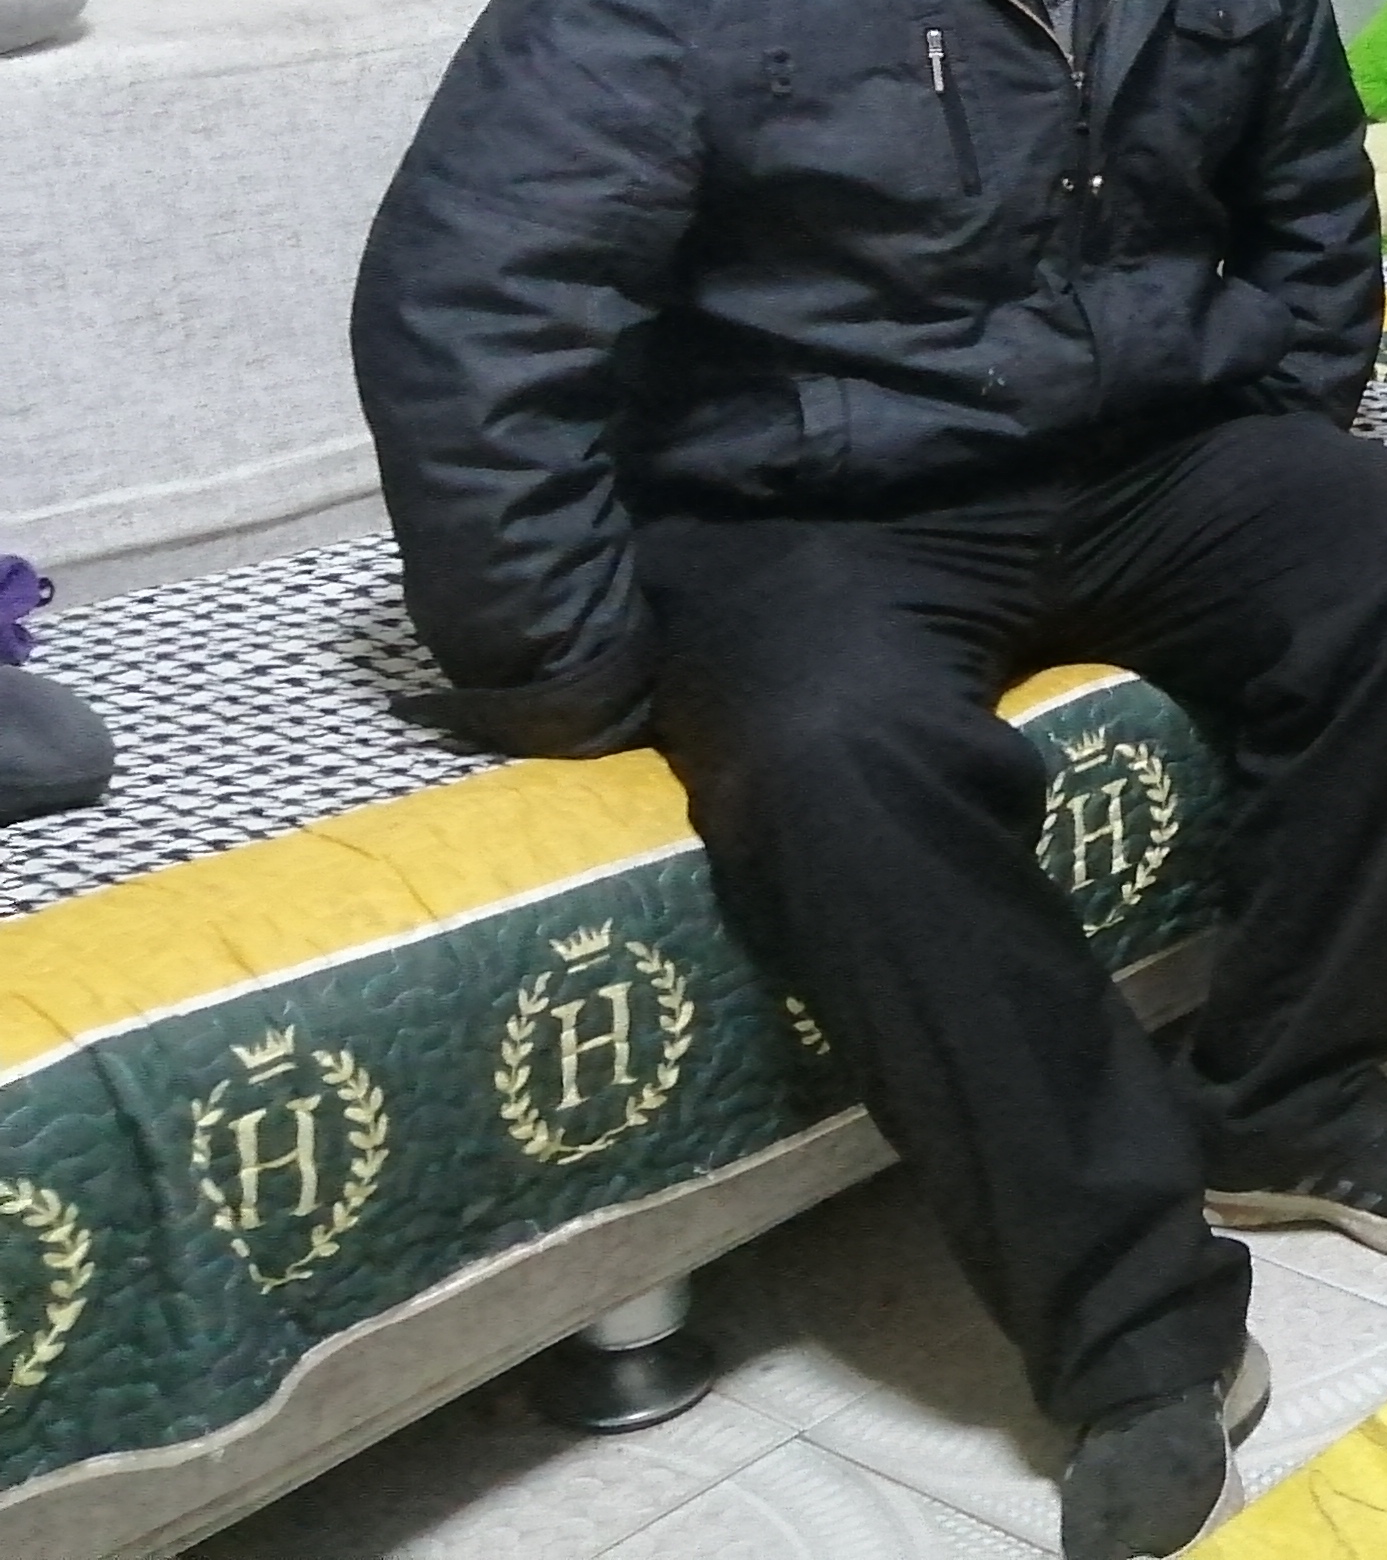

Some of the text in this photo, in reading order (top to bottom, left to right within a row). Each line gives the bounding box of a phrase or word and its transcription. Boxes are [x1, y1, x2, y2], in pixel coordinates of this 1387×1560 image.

[1066, 777, 1132, 894] H
[550, 981, 639, 1111] H
[228, 1094, 321, 1231] H
